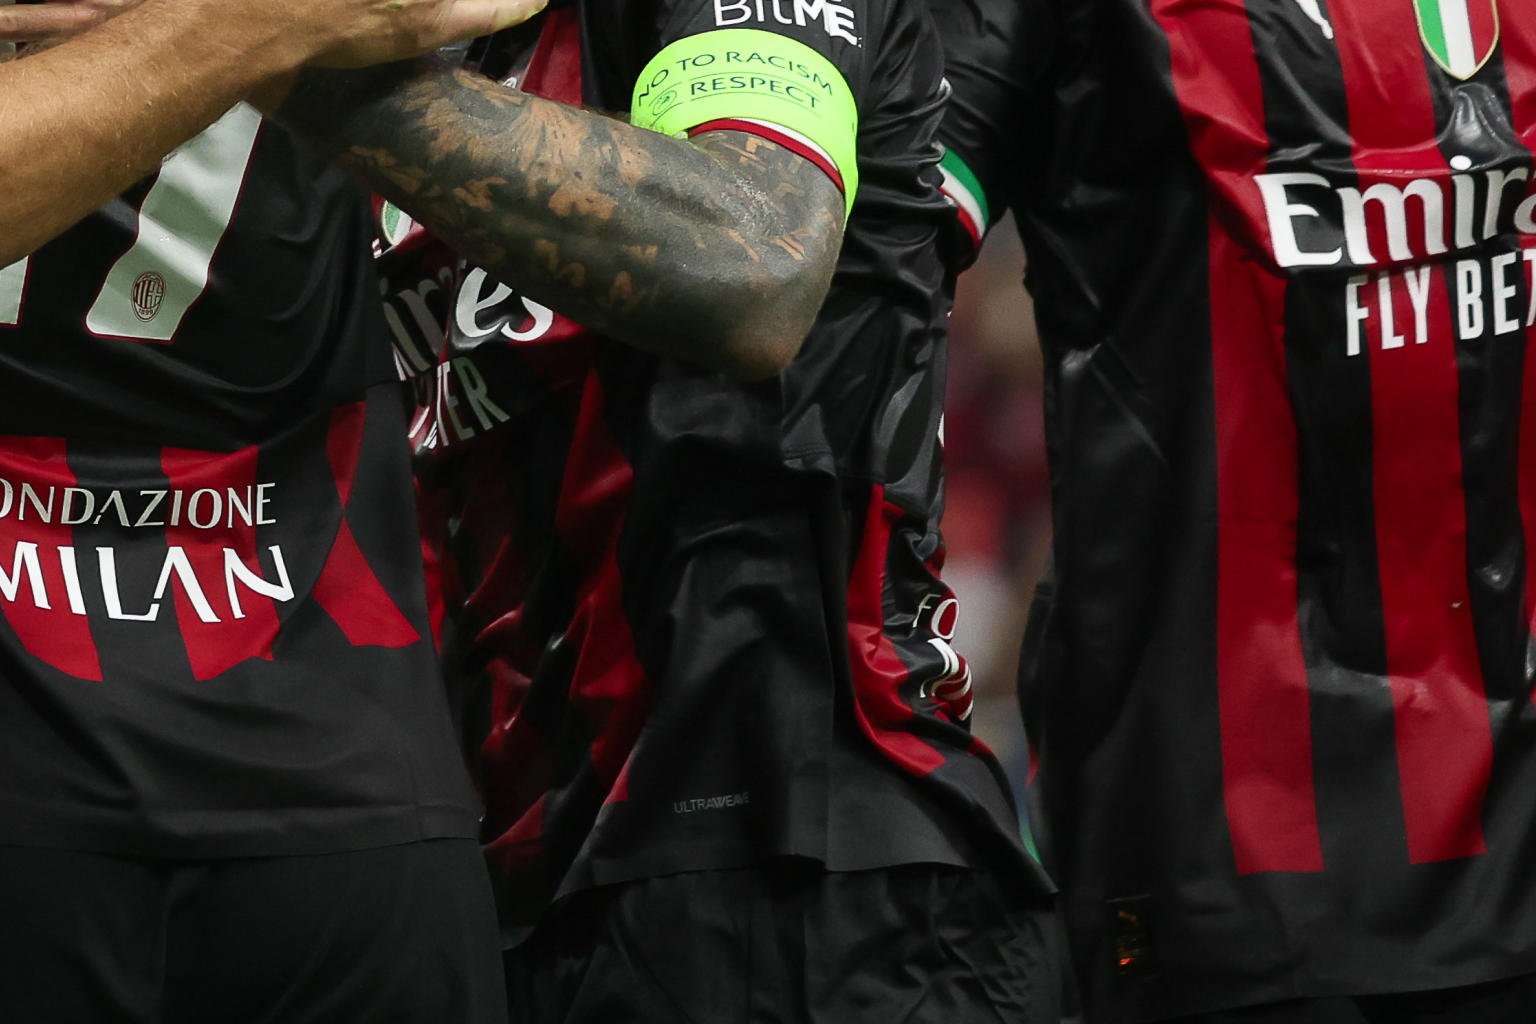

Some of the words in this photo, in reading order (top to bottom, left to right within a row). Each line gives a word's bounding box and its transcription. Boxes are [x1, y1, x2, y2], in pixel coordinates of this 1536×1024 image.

[638, 68, 670, 108] NO
[675, 53, 716, 72] TO
[726, 51, 833, 96] RACISM
[691, 76, 821, 108] RESPECT
[1345, 263, 1431, 357] FLY
